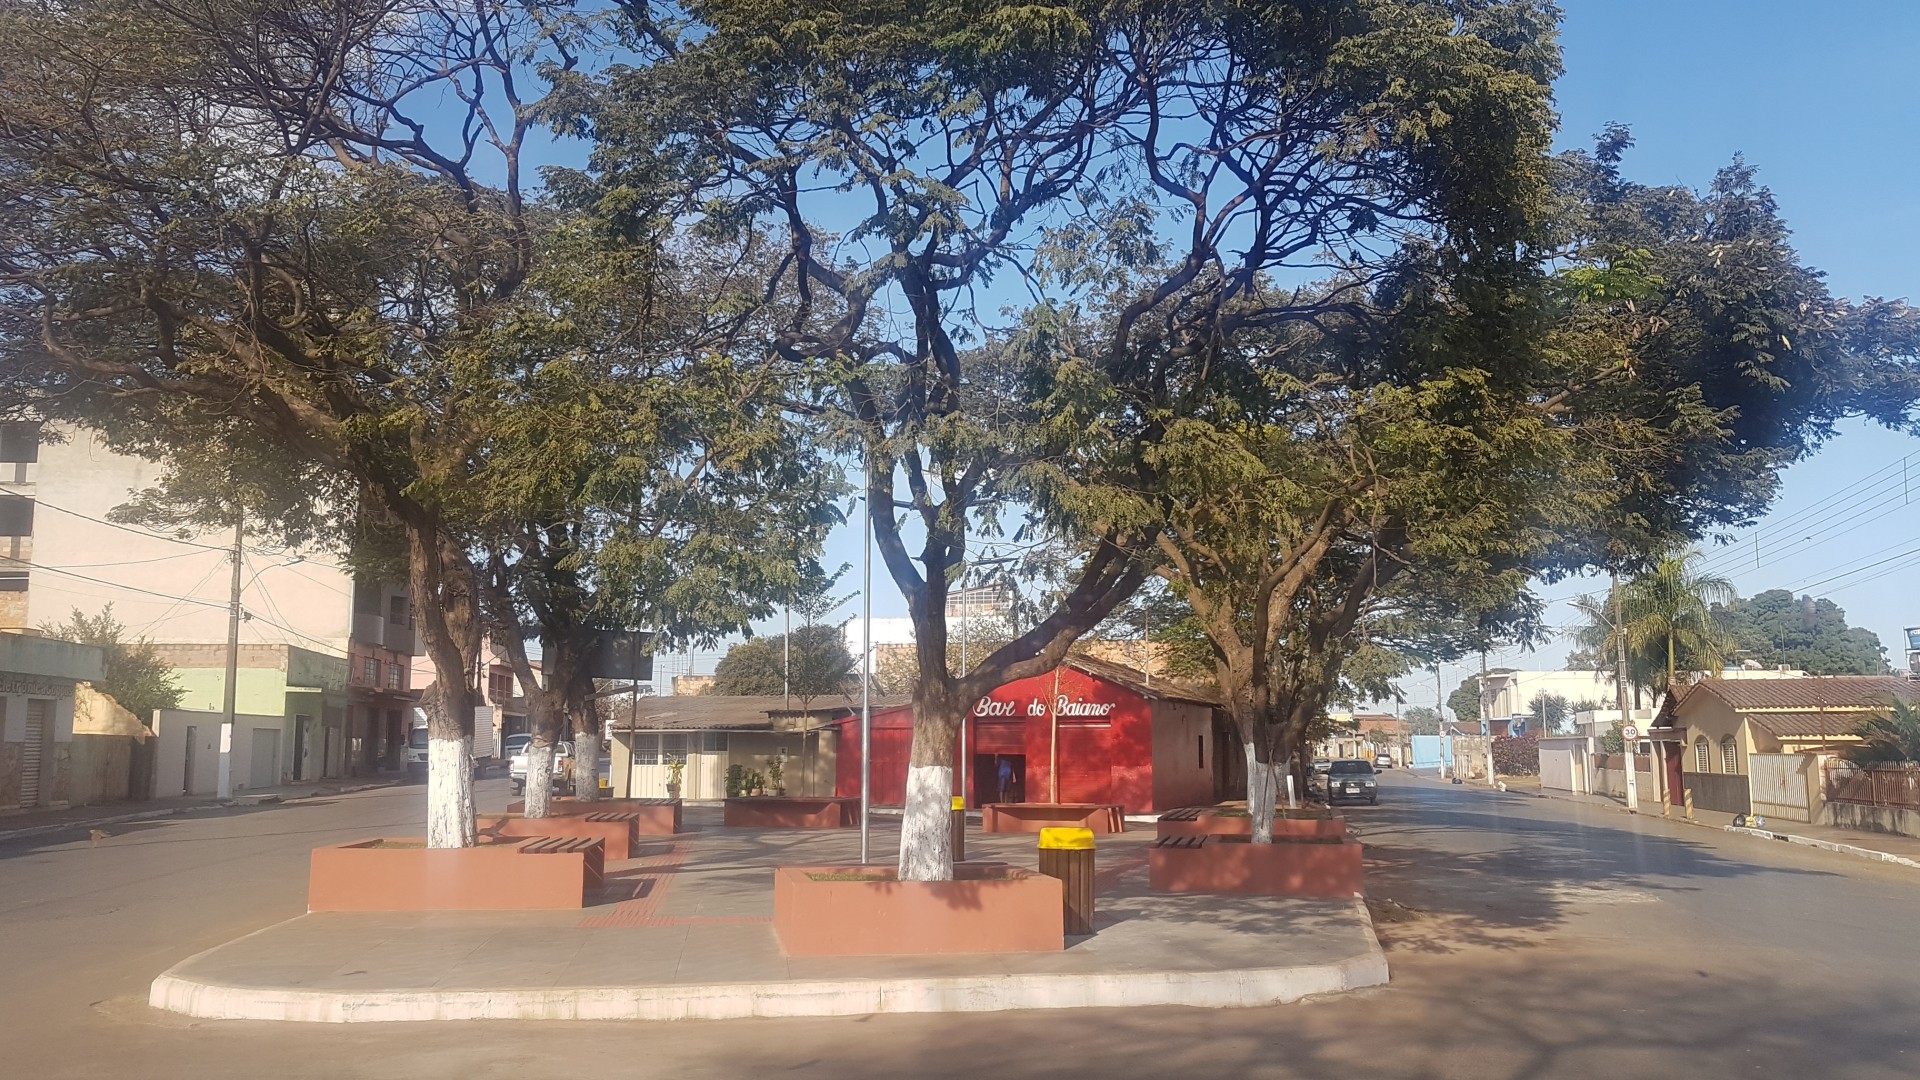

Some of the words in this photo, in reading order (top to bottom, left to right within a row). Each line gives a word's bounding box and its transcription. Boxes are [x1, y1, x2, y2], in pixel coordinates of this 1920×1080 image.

[973, 696, 1016, 717] Bar
[1027, 698, 1046, 717] do
[1055, 695, 1115, 717] Baiano
